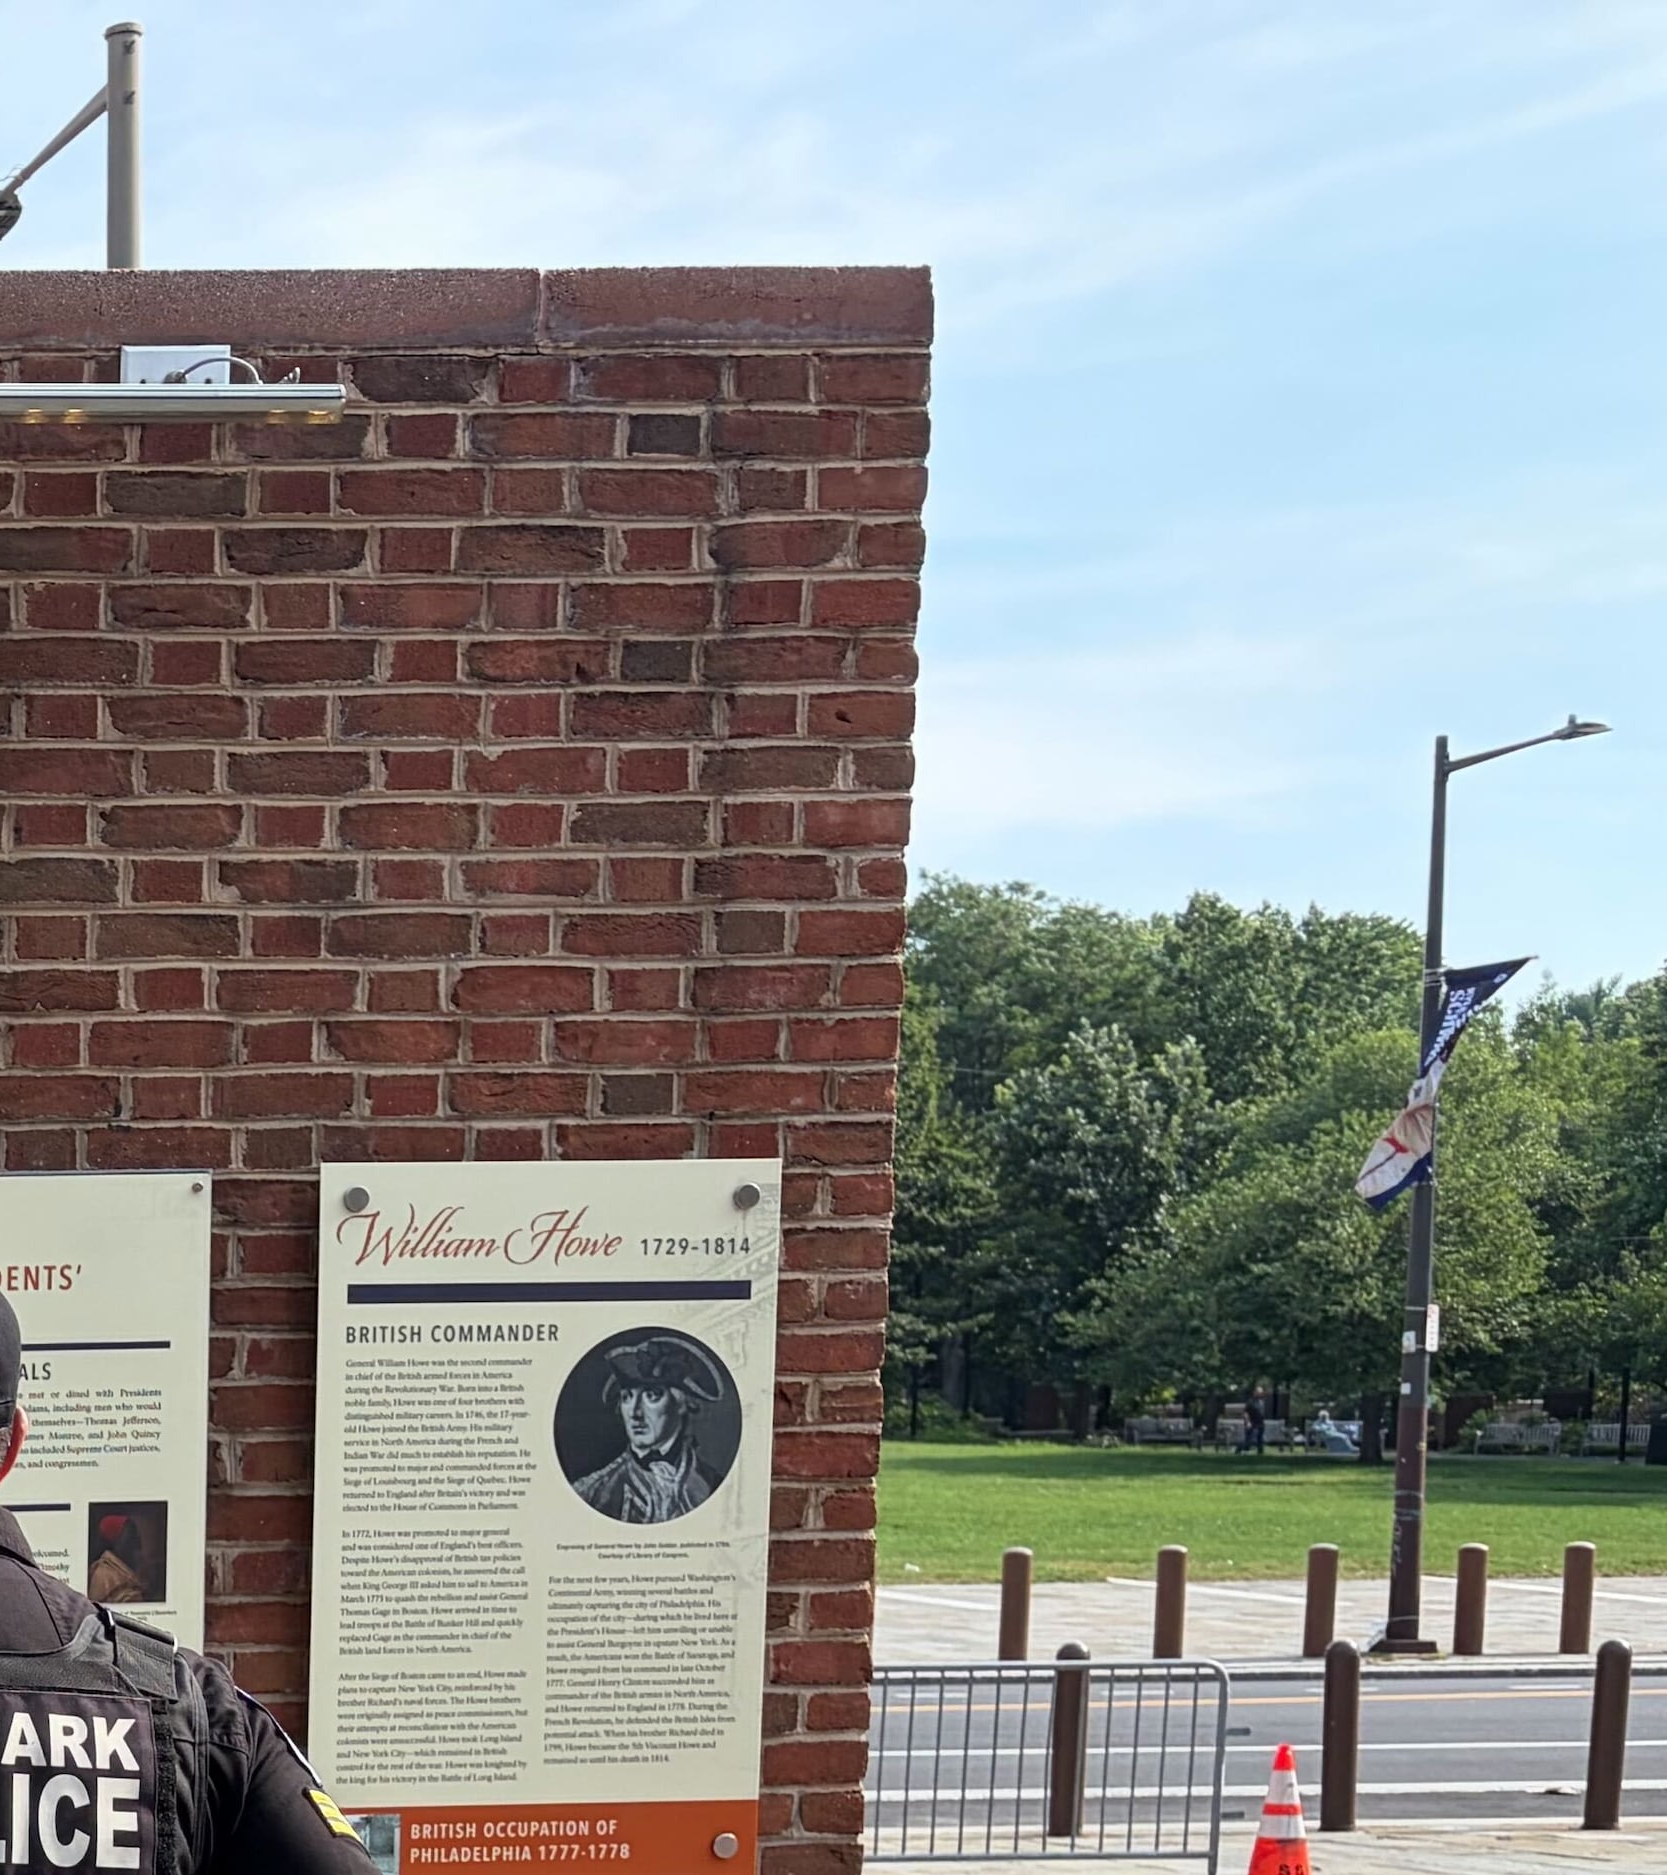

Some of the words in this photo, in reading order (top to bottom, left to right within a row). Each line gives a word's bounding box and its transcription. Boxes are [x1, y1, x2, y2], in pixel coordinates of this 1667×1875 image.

[337, 1203, 499, 1266] William
[504, 1205, 621, 1266] Howe
[641, 1237, 750, 1255] 1729-1814
[346, 1325, 421, 1343] BRITISH
[431, 1324, 558, 1342] COMMANDER
[19, 1362, 51, 1380] ALS
[28, 1389, 45, 1398] met
[65, 1389, 90, 1397] dined
[95, 1388, 114, 1397] with
[411, 1823, 476, 1839] BRITISH
[484, 1821, 589, 1838] OCCUPATION
[596, 1820, 617, 1835] OF
[411, 1846, 531, 1863] PHILADELPHIA
[539, 1844, 629, 1860] 1777-1778
